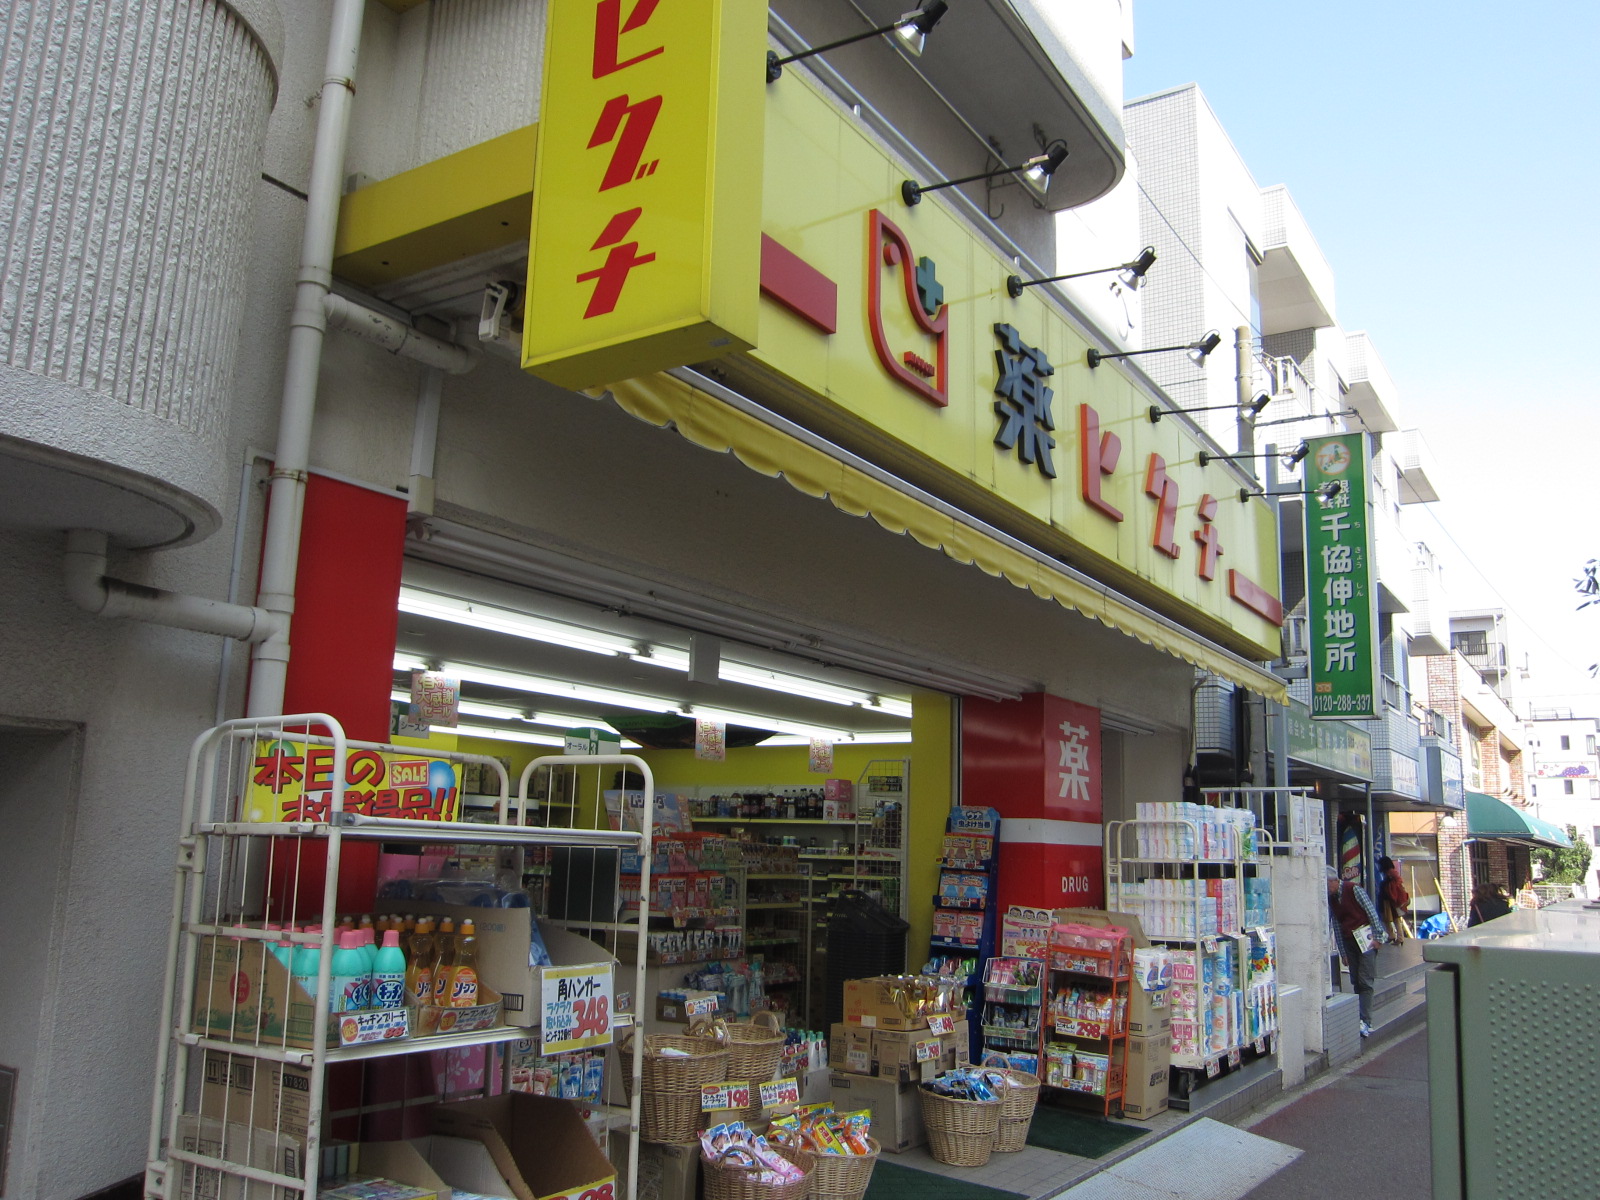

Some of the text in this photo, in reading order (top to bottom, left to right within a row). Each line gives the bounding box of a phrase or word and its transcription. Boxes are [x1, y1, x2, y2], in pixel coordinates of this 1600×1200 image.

[1320, 511, 1357, 672] 千協伸地所
[1313, 694, 1371, 711] 0120-288-337
[423, 706, 451, 717] セール
[1059, 720, 1090, 801] 薬
[254, 748, 427, 794] 本日の SALE
[1061, 876, 1089, 893] DRUG
[557, 975, 601, 1002] 角ハンガー
[546, 1000, 572, 1015] ラクラク
[357, 1010, 406, 1026] キッチンブリーチ
[571, 994, 609, 1040] 348
[383, 1026, 405, 1038] 88
[1076, 1021, 1101, 1038] 298
[283, 1076, 308, 1090] 17820
[726, 1088, 749, 1109] 198
[777, 1088, 798, 1105] 598
